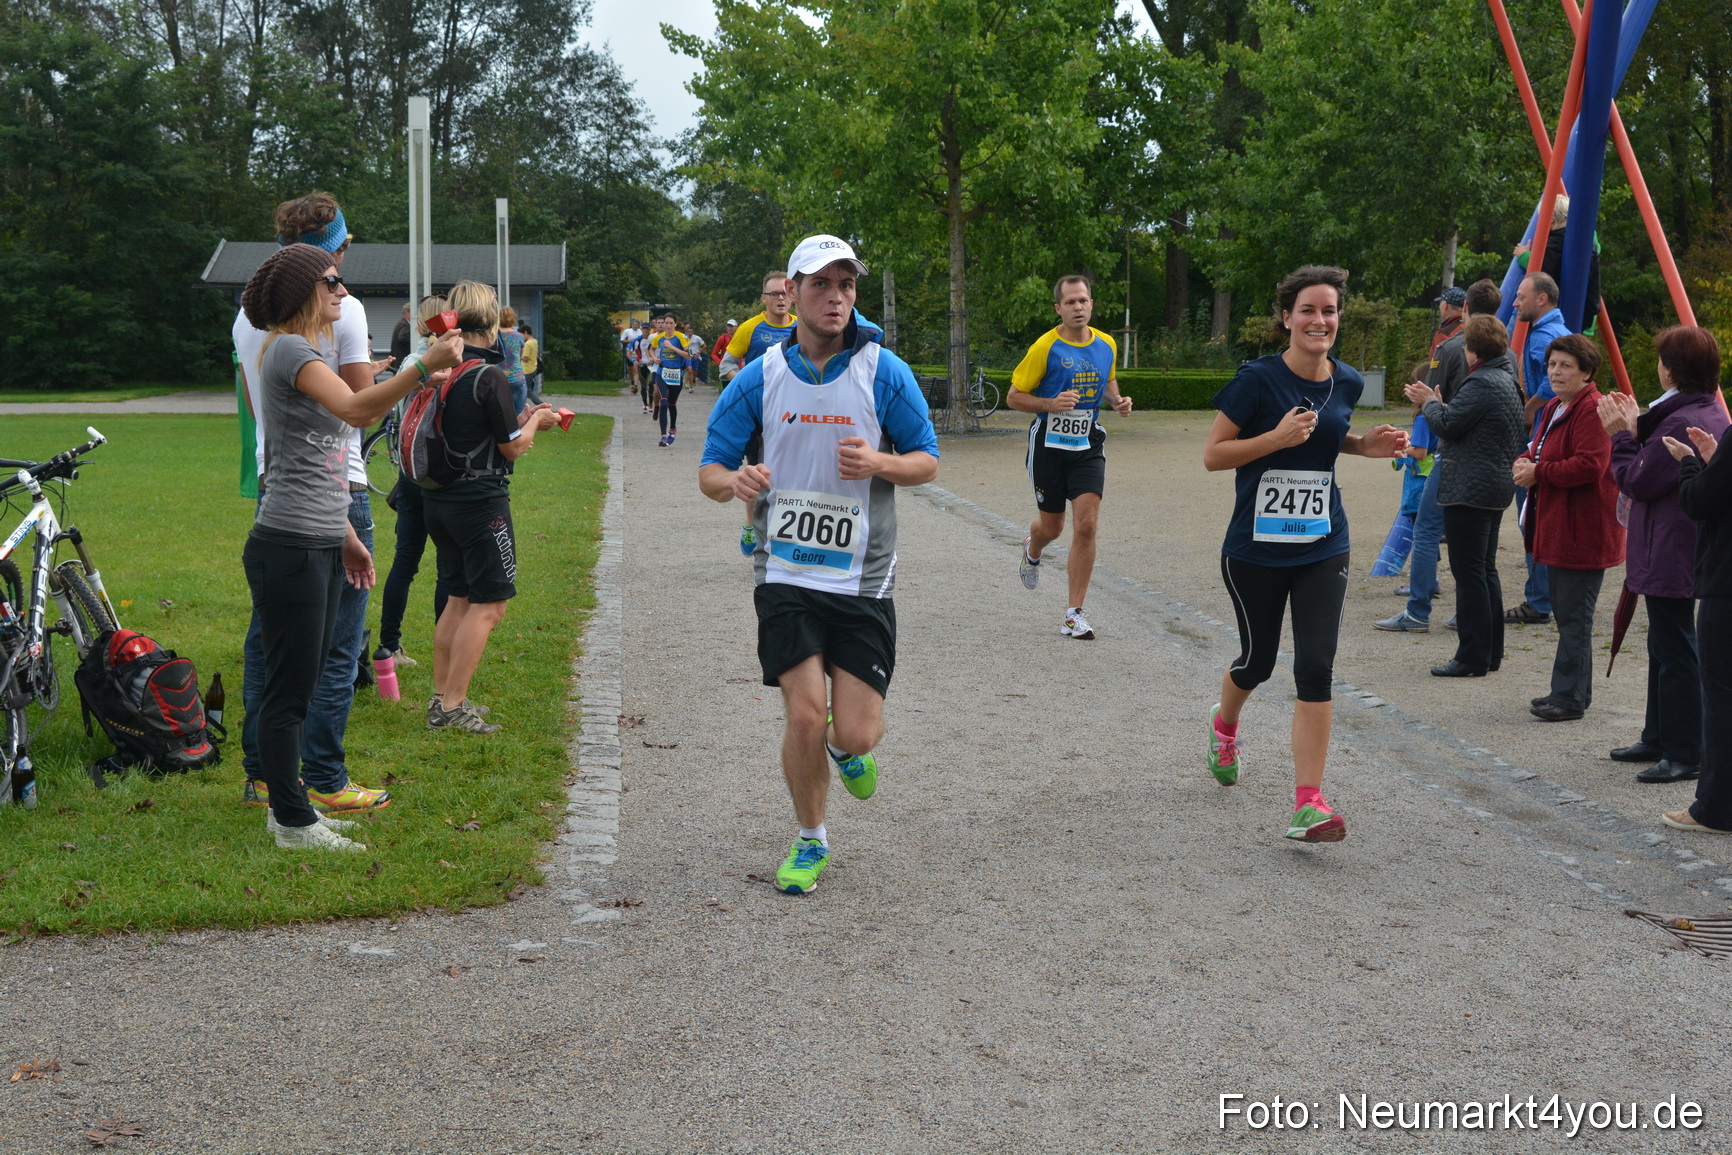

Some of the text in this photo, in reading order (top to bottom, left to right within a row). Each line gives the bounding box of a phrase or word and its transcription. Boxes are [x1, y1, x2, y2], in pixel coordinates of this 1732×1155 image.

[800, 414, 856, 426] KLEBL
[1052, 417, 1089, 435] 2869
[1059, 436, 1079, 445] Martin
[1260, 476, 1320, 486] PARTL Neumarkt
[777, 497, 849, 514] PARTL Neumarkt
[1263, 487, 1324, 516] 2475
[10, 519, 32, 544] STING
[777, 510, 853, 548] 2060
[1281, 521, 1307, 533] Julia
[792, 548, 826, 565] Georg
